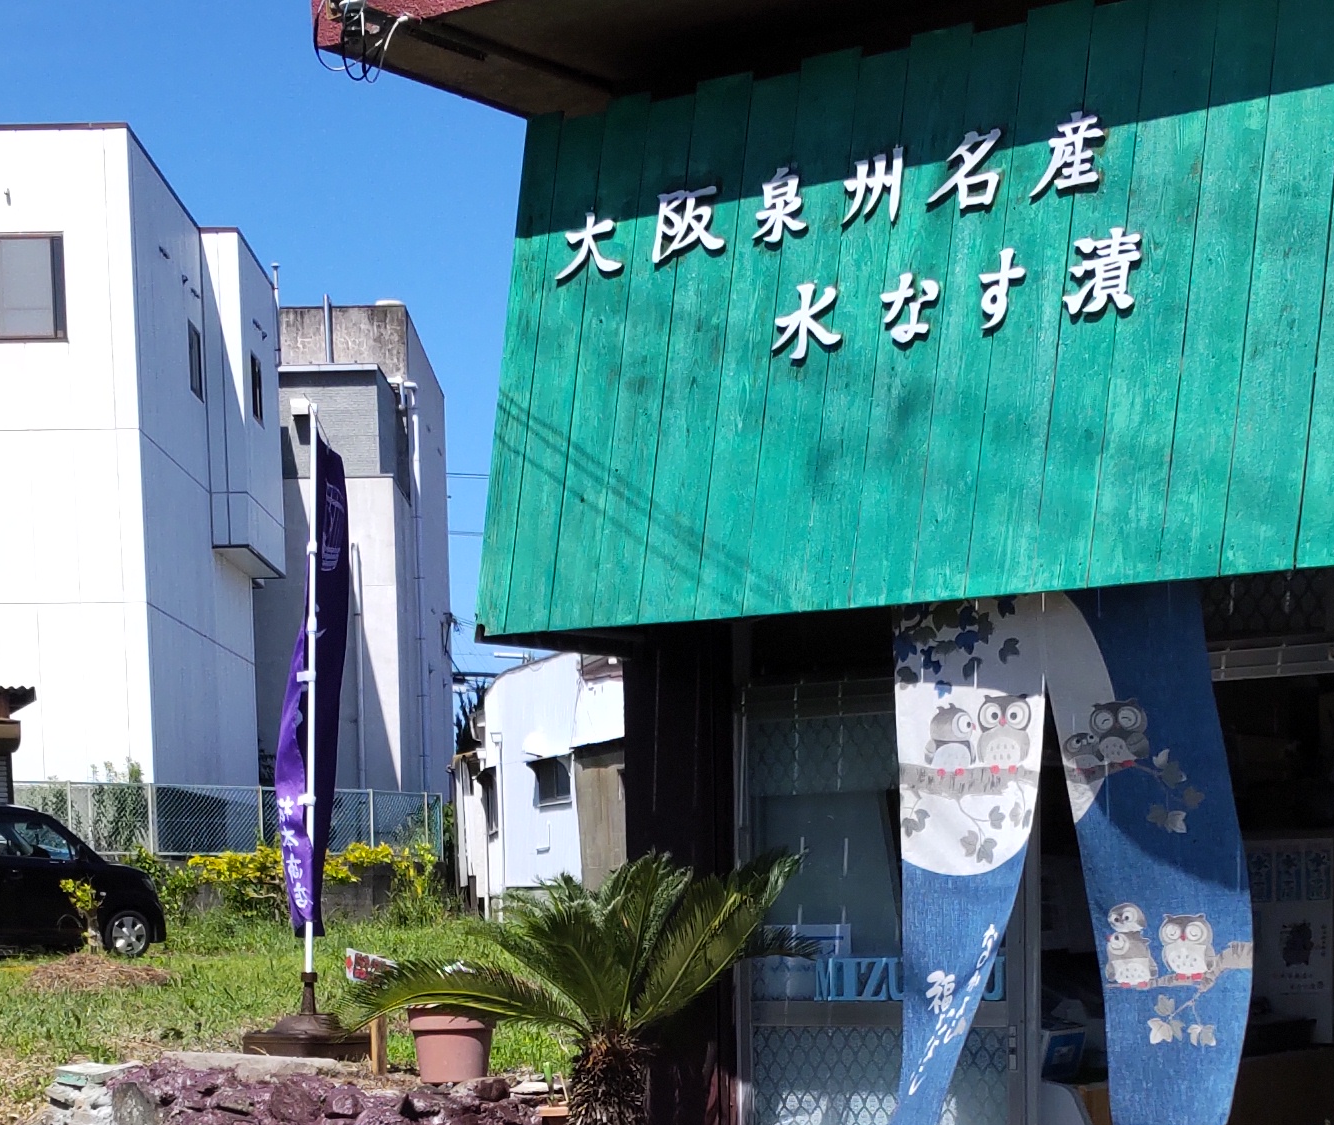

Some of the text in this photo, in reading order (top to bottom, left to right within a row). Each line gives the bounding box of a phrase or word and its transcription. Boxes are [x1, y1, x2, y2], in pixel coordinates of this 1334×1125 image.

[555, 111, 1106, 282] 大阪泉州名産
[771, 227, 1142, 361] 水なす漬
